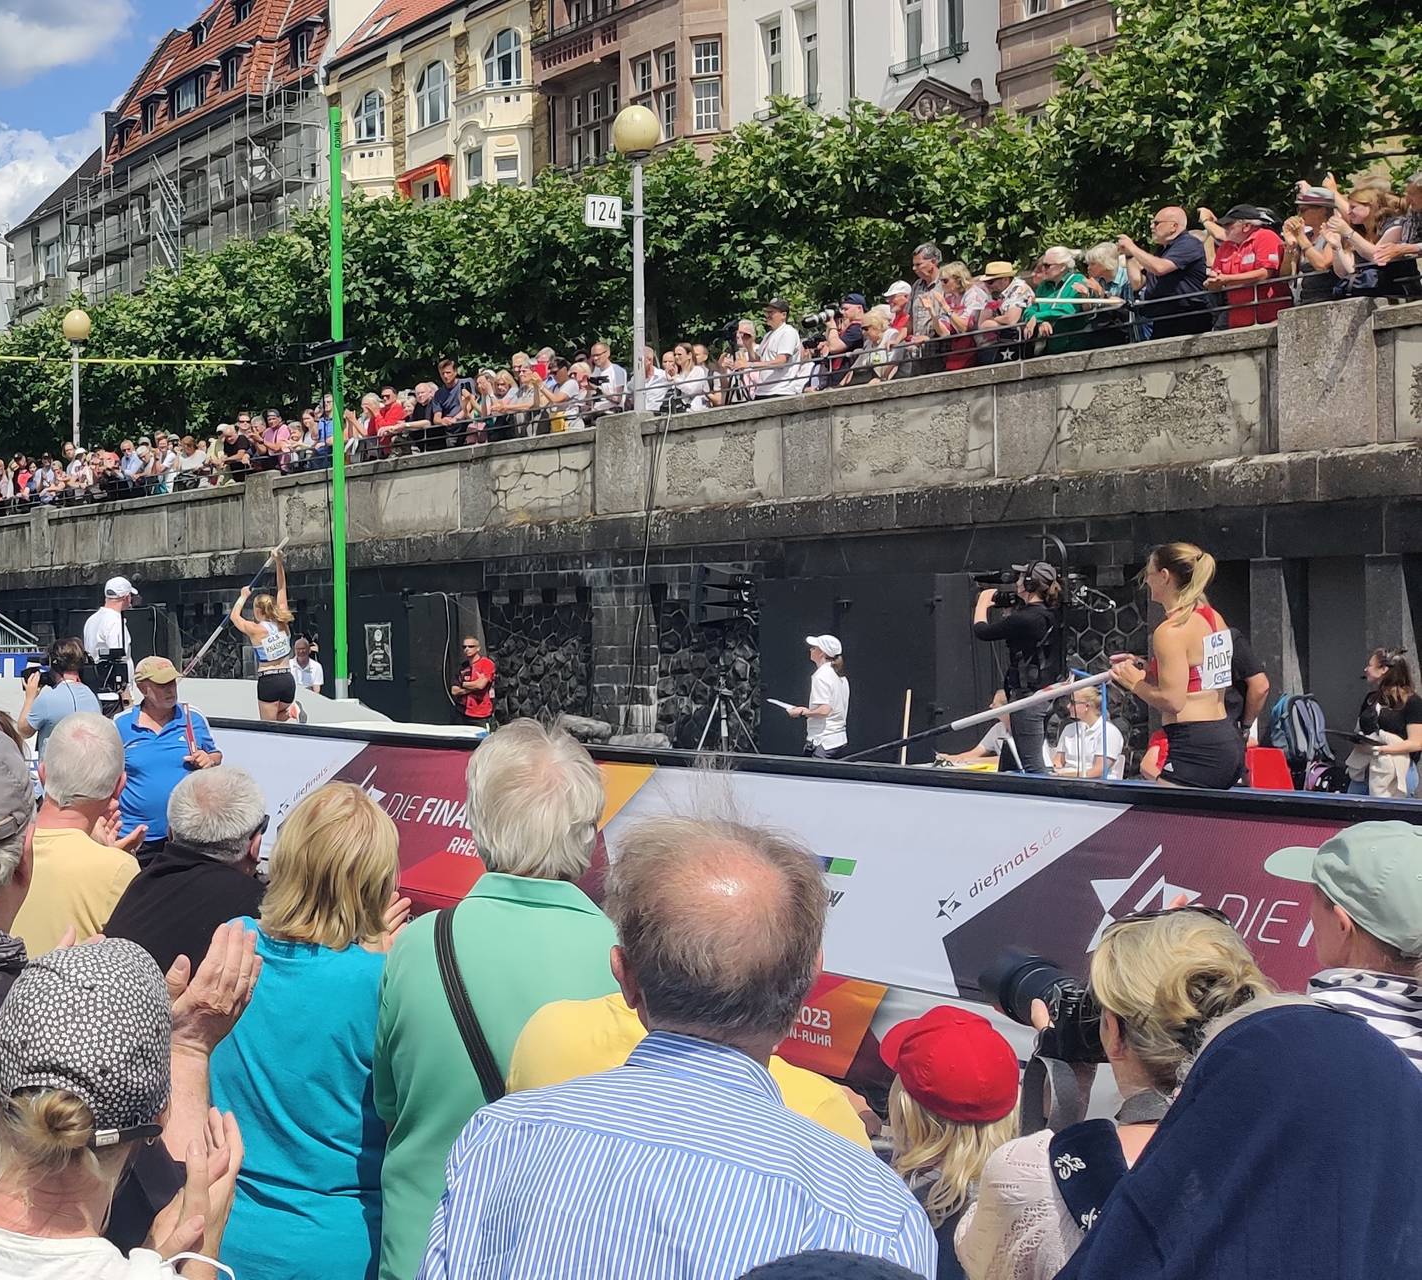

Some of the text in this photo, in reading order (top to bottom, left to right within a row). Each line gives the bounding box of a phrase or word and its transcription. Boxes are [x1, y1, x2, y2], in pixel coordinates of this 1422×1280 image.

[590, 200, 617, 222] 124
[388, 793, 422, 822] DIE
[446, 836, 481, 859] RHEI
[969, 826, 1064, 898] diefinals.de
[1216, 893, 1299, 944] DIE
[795, 1005, 831, 1030] 023
